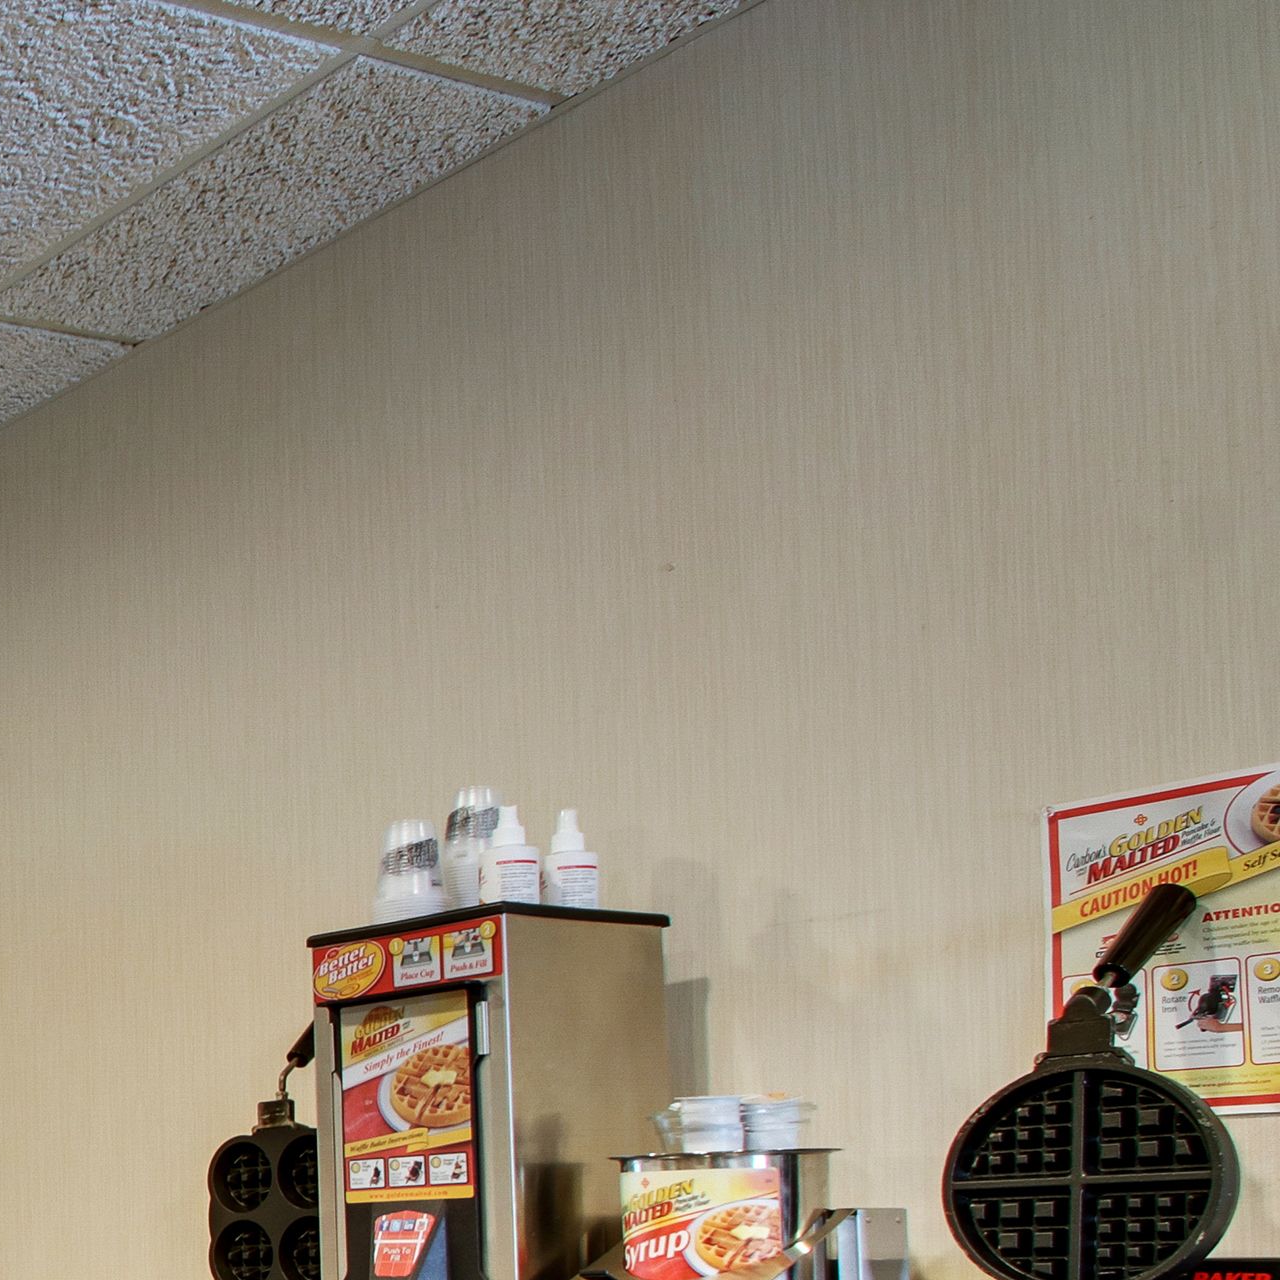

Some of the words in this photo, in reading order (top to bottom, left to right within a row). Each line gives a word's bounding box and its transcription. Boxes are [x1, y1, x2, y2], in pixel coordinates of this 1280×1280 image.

[1065, 844, 1107, 873] Carbon's
[1109, 805, 1204, 858] GOLDEN
[1086, 833, 1180, 885] MALTED
[1243, 851, 1269, 872] Self
[1079, 876, 1154, 918] CAUTION
[1157, 859, 1198, 885] HOT!
[318, 945, 368, 978] Better
[328, 953, 376, 986] Batter
[401, 970, 418, 980] Place
[419, 968, 435, 978] Cup
[1263, 963, 1273, 975] 3
[1170, 974, 1180, 985] 2
[1162, 995, 1187, 1004] Rotate
[351, 1023, 400, 1057] MALTED
[363, 1053, 394, 1075] Simply
[396, 1047, 411, 1060] the
[412, 1031, 445, 1054] Finest!
[624, 1200, 673, 1232] MALTED
[383, 1247, 401, 1255] Push
[624, 1229, 690, 1271] Syrup
